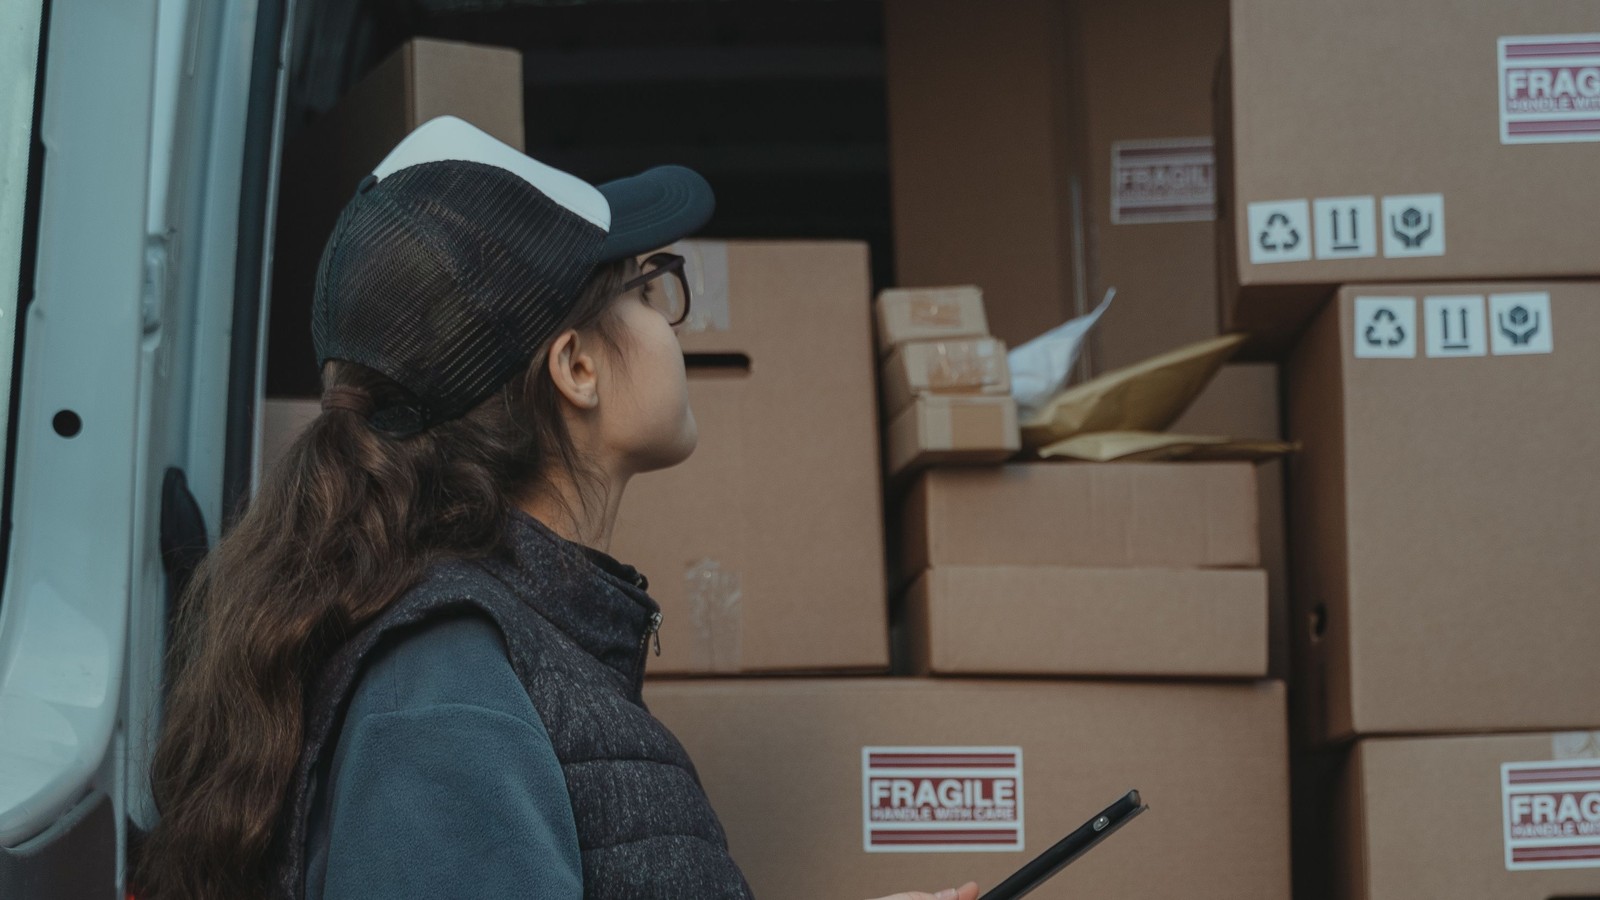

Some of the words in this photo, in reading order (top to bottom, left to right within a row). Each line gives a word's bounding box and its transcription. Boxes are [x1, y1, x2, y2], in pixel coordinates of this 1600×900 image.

[1508, 68, 1600, 98] FRAG
[1508, 97, 1571, 112] HANDLE
[1118, 165, 1214, 191] FRAGIL
[871, 779, 1015, 807] FRAGILE
[871, 807, 932, 821] HANDLE
[934, 807, 973, 821] WITH
[974, 807, 1014, 821] CARE
[1511, 793, 1600, 824] FRAG
[1512, 822, 1575, 837] HANDLE
